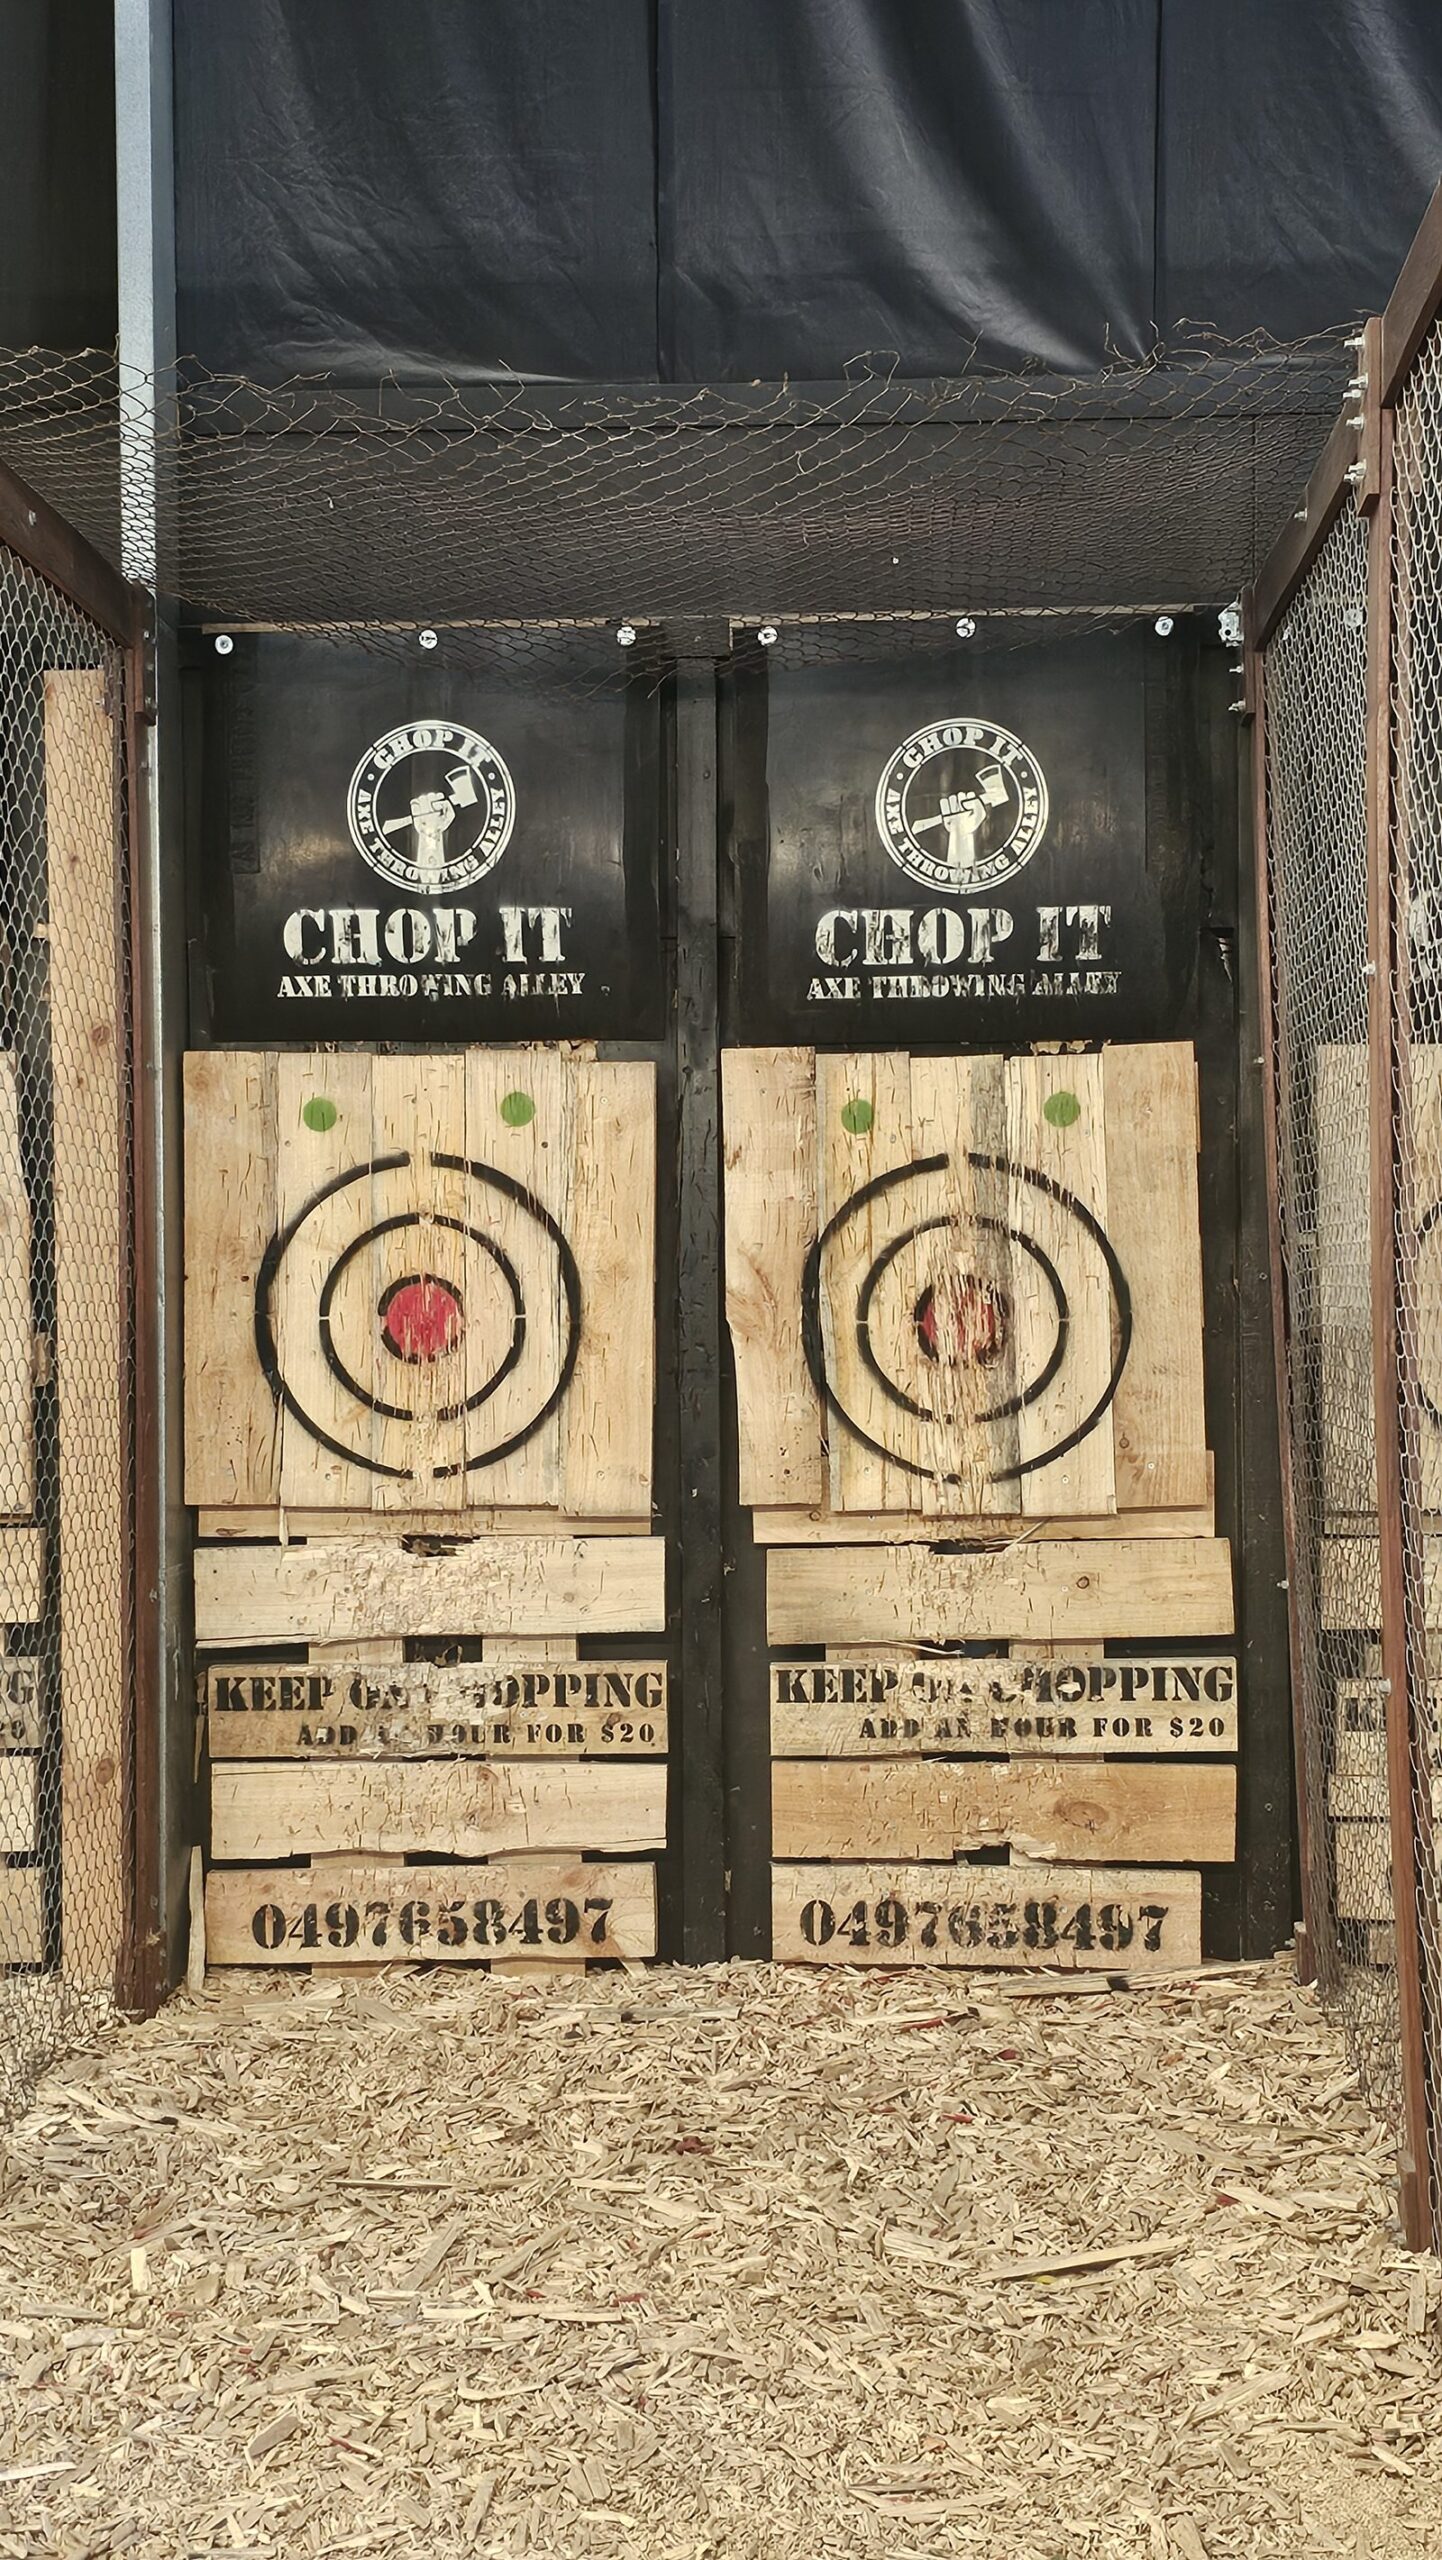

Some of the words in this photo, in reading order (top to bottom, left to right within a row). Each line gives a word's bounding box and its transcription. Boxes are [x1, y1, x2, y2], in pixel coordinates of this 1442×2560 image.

[374, 729, 453, 769] CHOP
[459, 737, 492, 767] IT
[902, 727, 984, 768] CHOP
[989, 736, 1023, 766] IT
[358, 788, 375, 835] AXE
[479, 788, 506, 857] ALLEY
[886, 787, 904, 835] AXE
[898, 837, 1010, 883] THROWING
[1010, 786, 1039, 856] ALLEY
[283, 908, 478, 966] CHOP
[499, 907, 573, 963] IT
[815, 907, 1014, 967] CHOP
[1036, 905, 1112, 961] IT
[277, 975, 330, 998] AXE
[807, 976, 861, 1000] AXE
[868, 974, 1025, 998] THROWING
[214, 1675, 334, 1711] KEEP
[425, 1673, 664, 1709] OPPING
[776, 1667, 898, 1703] KEEP
[528, 1724, 585, 1743] FOR
[602, 1722, 655, 1744] $20
[860, 1717, 920, 1738] ADD
[990, 1717, 1078, 1738] HOUR
[1093, 1717, 1153, 1738] FOR
[1170, 1716, 1226, 1738] $20
[252, 1897, 613, 1948] 0497658497
